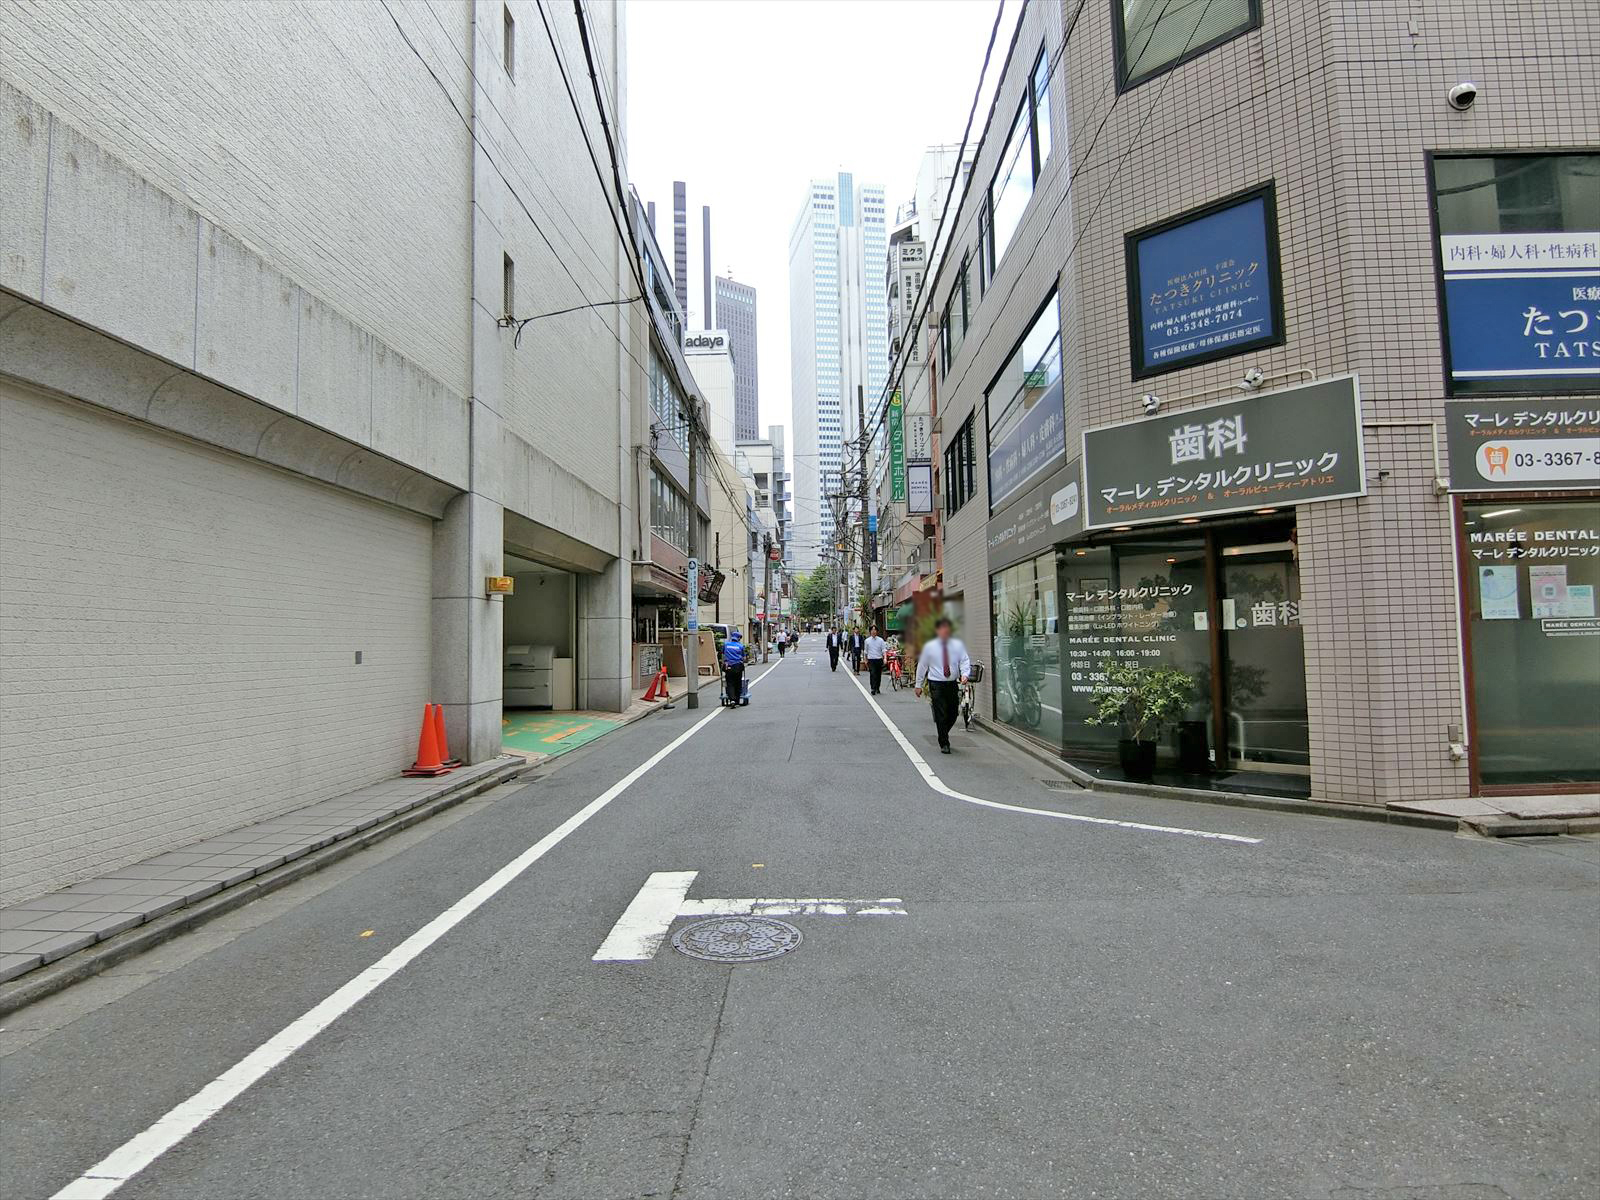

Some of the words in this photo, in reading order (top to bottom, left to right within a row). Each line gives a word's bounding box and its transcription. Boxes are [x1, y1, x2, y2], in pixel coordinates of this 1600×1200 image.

[902, 247, 923, 256] ミクラ
[1450, 243, 1598, 261] 内科・婦人科・性病科
[1150, 262, 1259, 306] たつきクリニック
[1154, 295, 1204, 315] TATSUKI
[1210, 281, 1251, 299] CLINIC
[1167, 309, 1243, 337] 03-5348-7074
[1522, 306, 1600, 337] たつ
[1464, 413, 1509, 428] マーレ
[1168, 414, 1248, 465] 歯科
[1100, 482, 1152, 503] マーレ
[1156, 452, 1339, 497] デンタルクリニック
[1106, 494, 1199, 514] オーラルメディカルクリニック
[1470, 528, 1528, 543] MARÉE
[1534, 530, 1600, 541] DENTAL
[1472, 548, 1504, 560] マーレ
[1506, 545, 1600, 559] デンタルクリニック
[1066, 591, 1094, 601] マーレ
[1097, 584, 1193, 600] デンタルクリニック
[1251, 601, 1300, 626] 歯科
[1069, 635, 1100, 644] MARÉE
